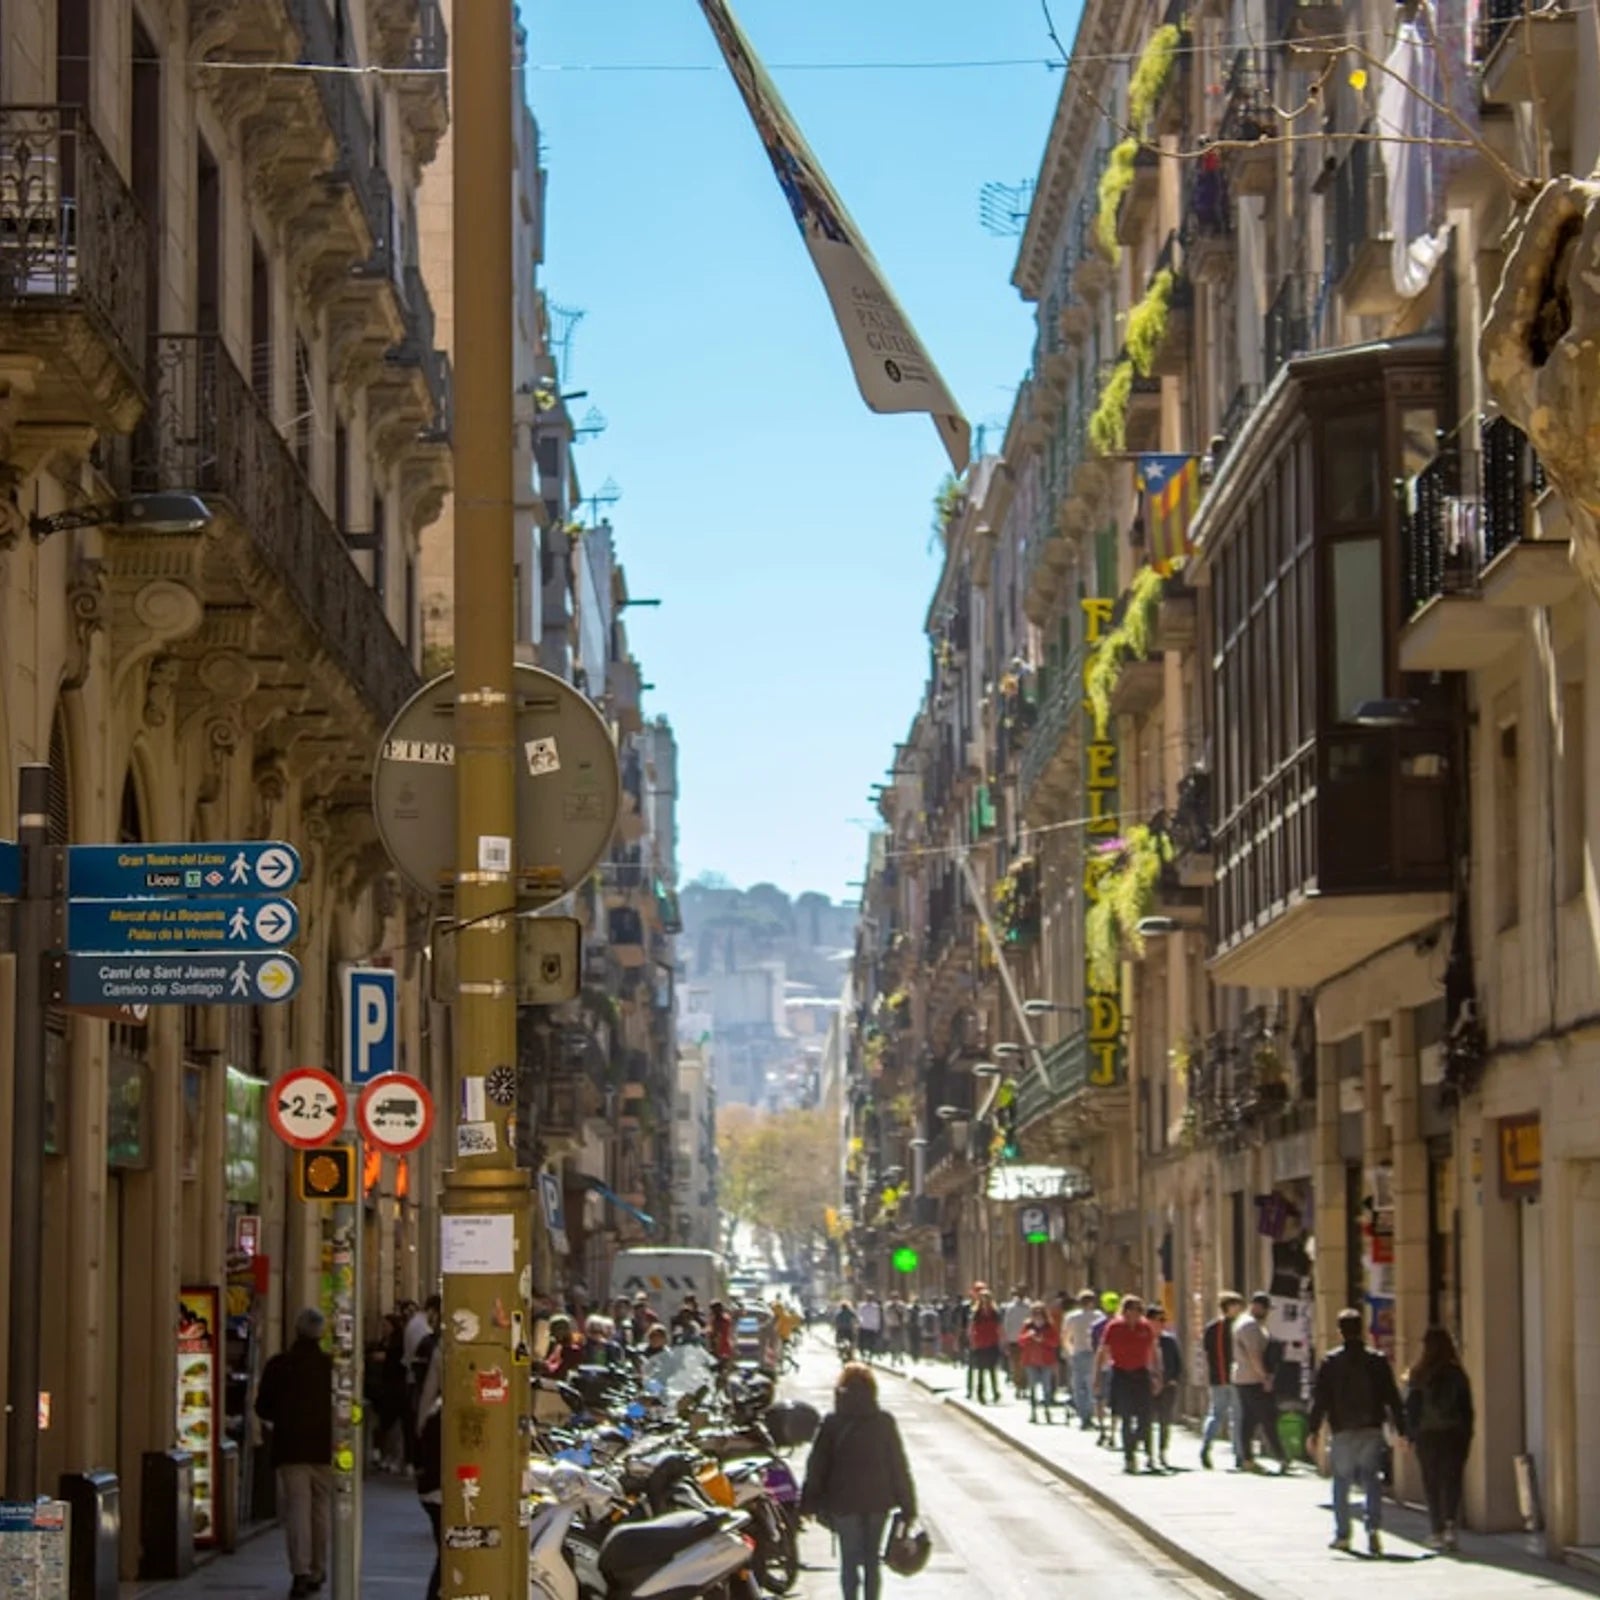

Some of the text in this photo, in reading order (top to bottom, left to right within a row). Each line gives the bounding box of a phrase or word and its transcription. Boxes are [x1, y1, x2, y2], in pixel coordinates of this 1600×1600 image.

[146, 873, 181, 887] Liceu
[99, 964, 227, 980] Camí de Sant Jaume
[103, 982, 224, 998] Camino de Santiago
[358, 984, 387, 1073] P
